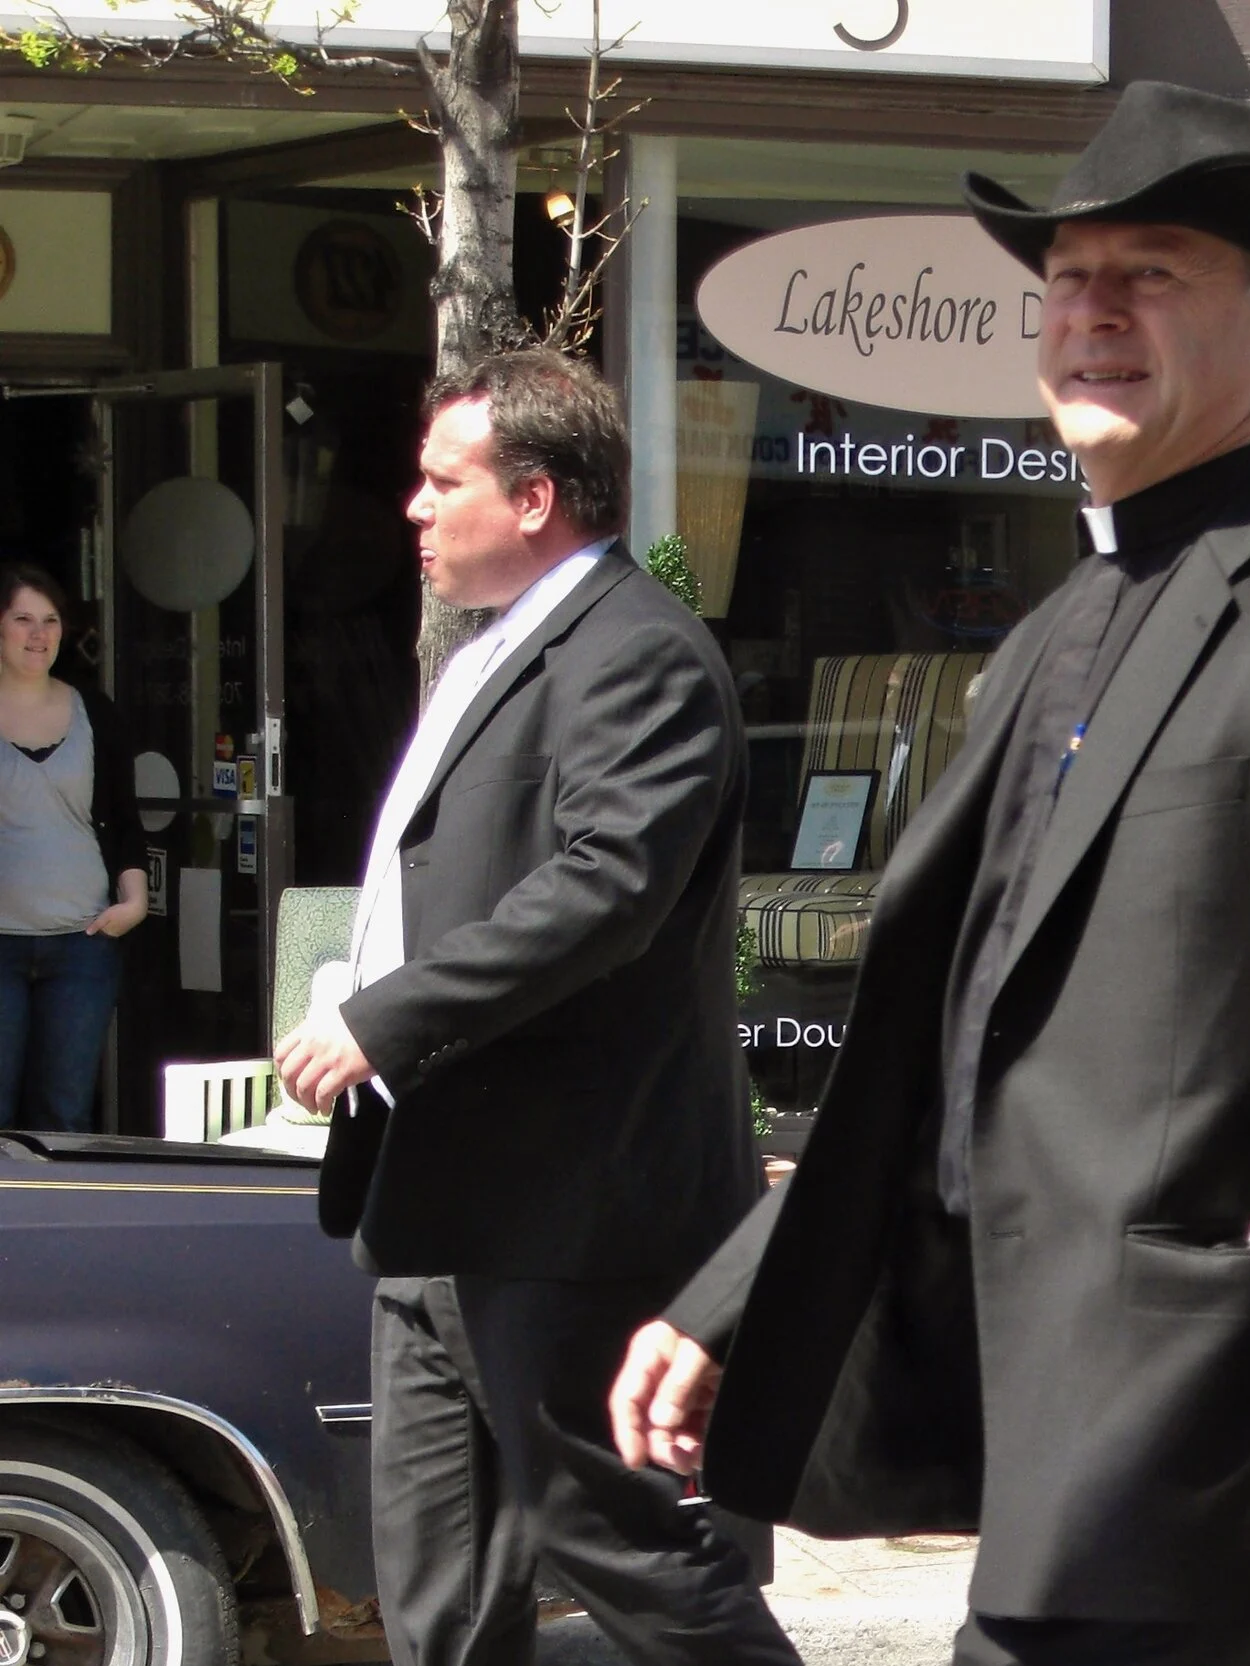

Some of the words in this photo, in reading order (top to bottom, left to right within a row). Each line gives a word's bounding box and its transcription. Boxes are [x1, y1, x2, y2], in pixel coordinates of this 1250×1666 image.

[774, 261, 998, 357] Lakeshore
[797, 431, 967, 478] Interior
[981, 437, 1092, 492] Desi
[215, 767, 236, 785] VISA
